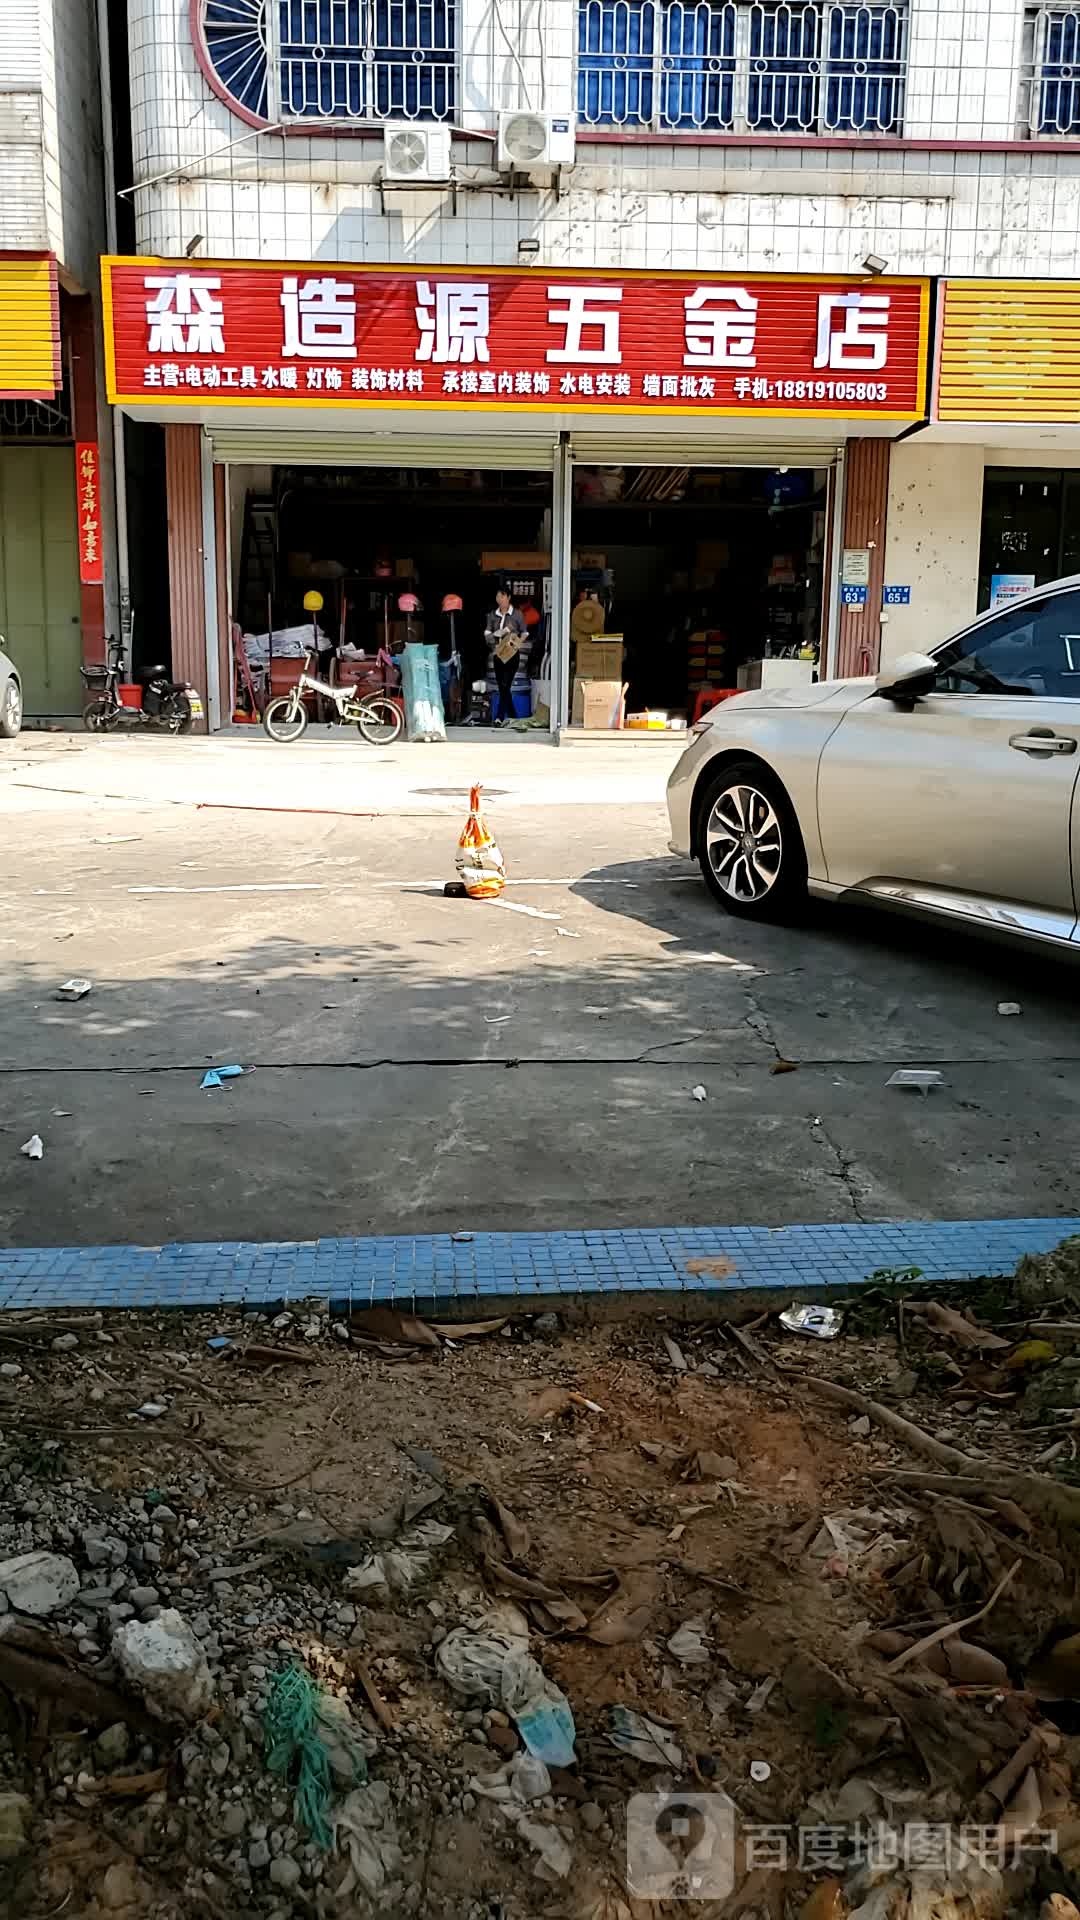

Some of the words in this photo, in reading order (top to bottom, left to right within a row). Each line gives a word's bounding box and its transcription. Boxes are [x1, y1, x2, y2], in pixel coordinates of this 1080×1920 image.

[143, 273, 891, 370] 森造源五金店
[305, 366, 343, 391] 灯饰
[351, 367, 425, 393] 装饰材料
[441, 369, 551, 396] 承接室内装饰
[559, 370, 632, 396] 水电安装
[642, 371, 717, 399] 墙面批灰
[845, 592, 858, 603] 63
[888, 593, 901, 603] 65
